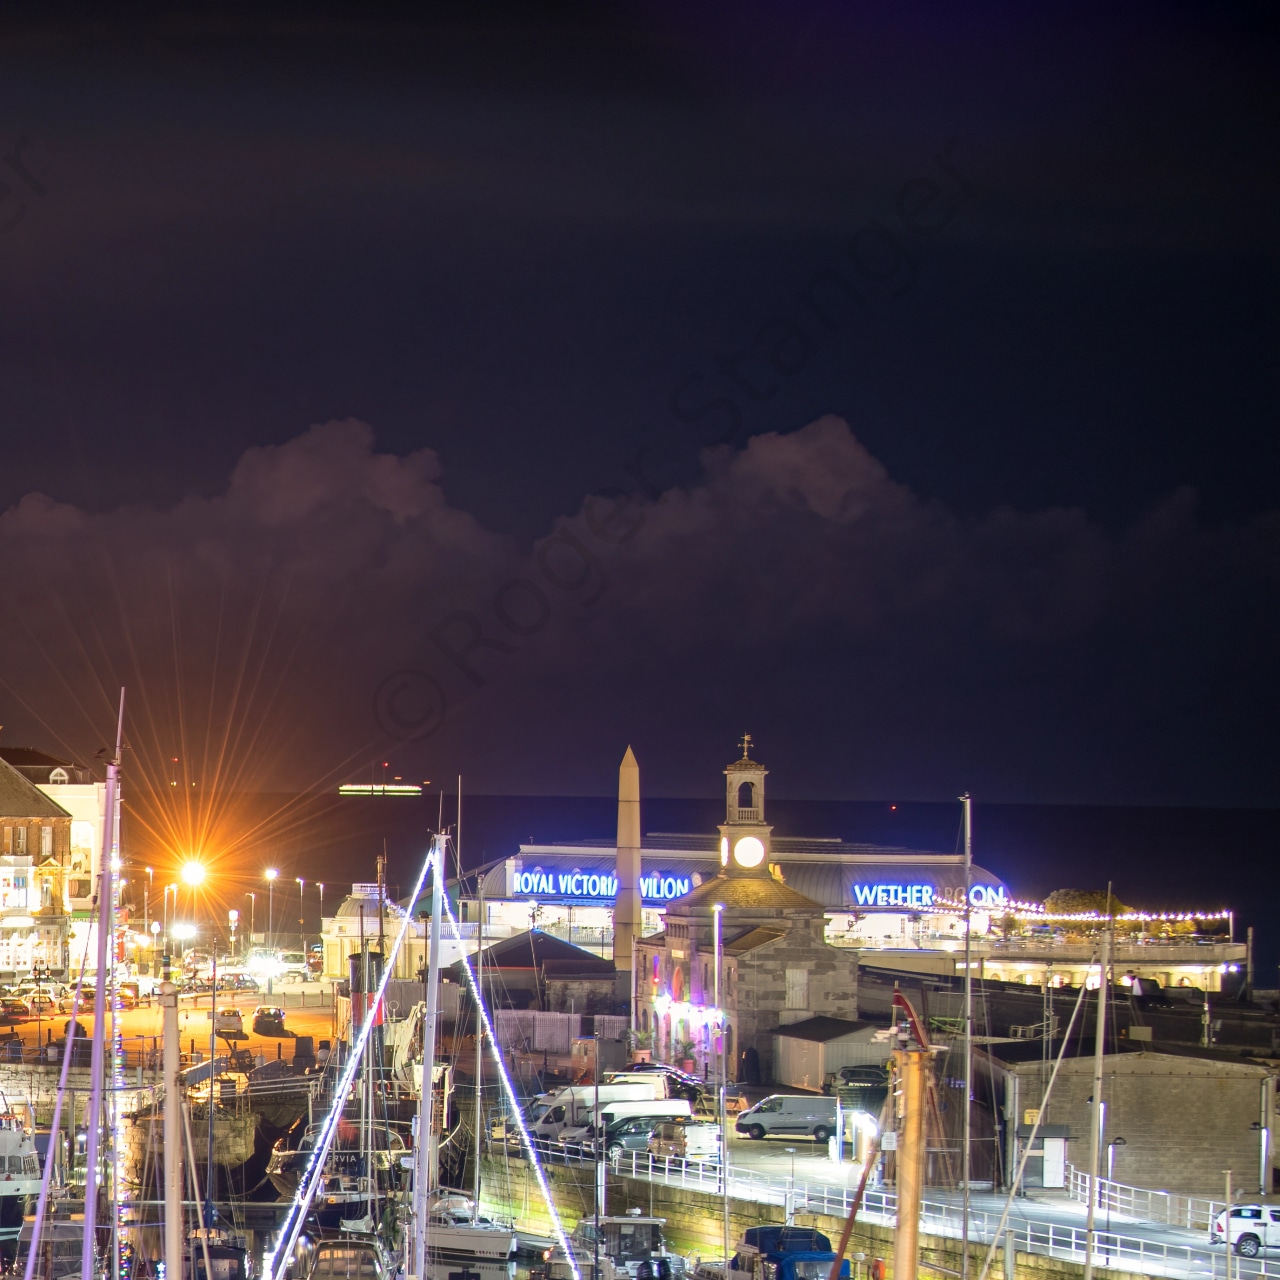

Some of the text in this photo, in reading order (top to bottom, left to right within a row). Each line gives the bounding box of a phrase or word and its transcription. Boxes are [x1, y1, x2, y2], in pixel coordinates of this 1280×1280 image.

[513, 873, 556, 894] ROYAL
[640, 877, 689, 899] VILION
[328, 1154, 357, 1163] ERVIA
